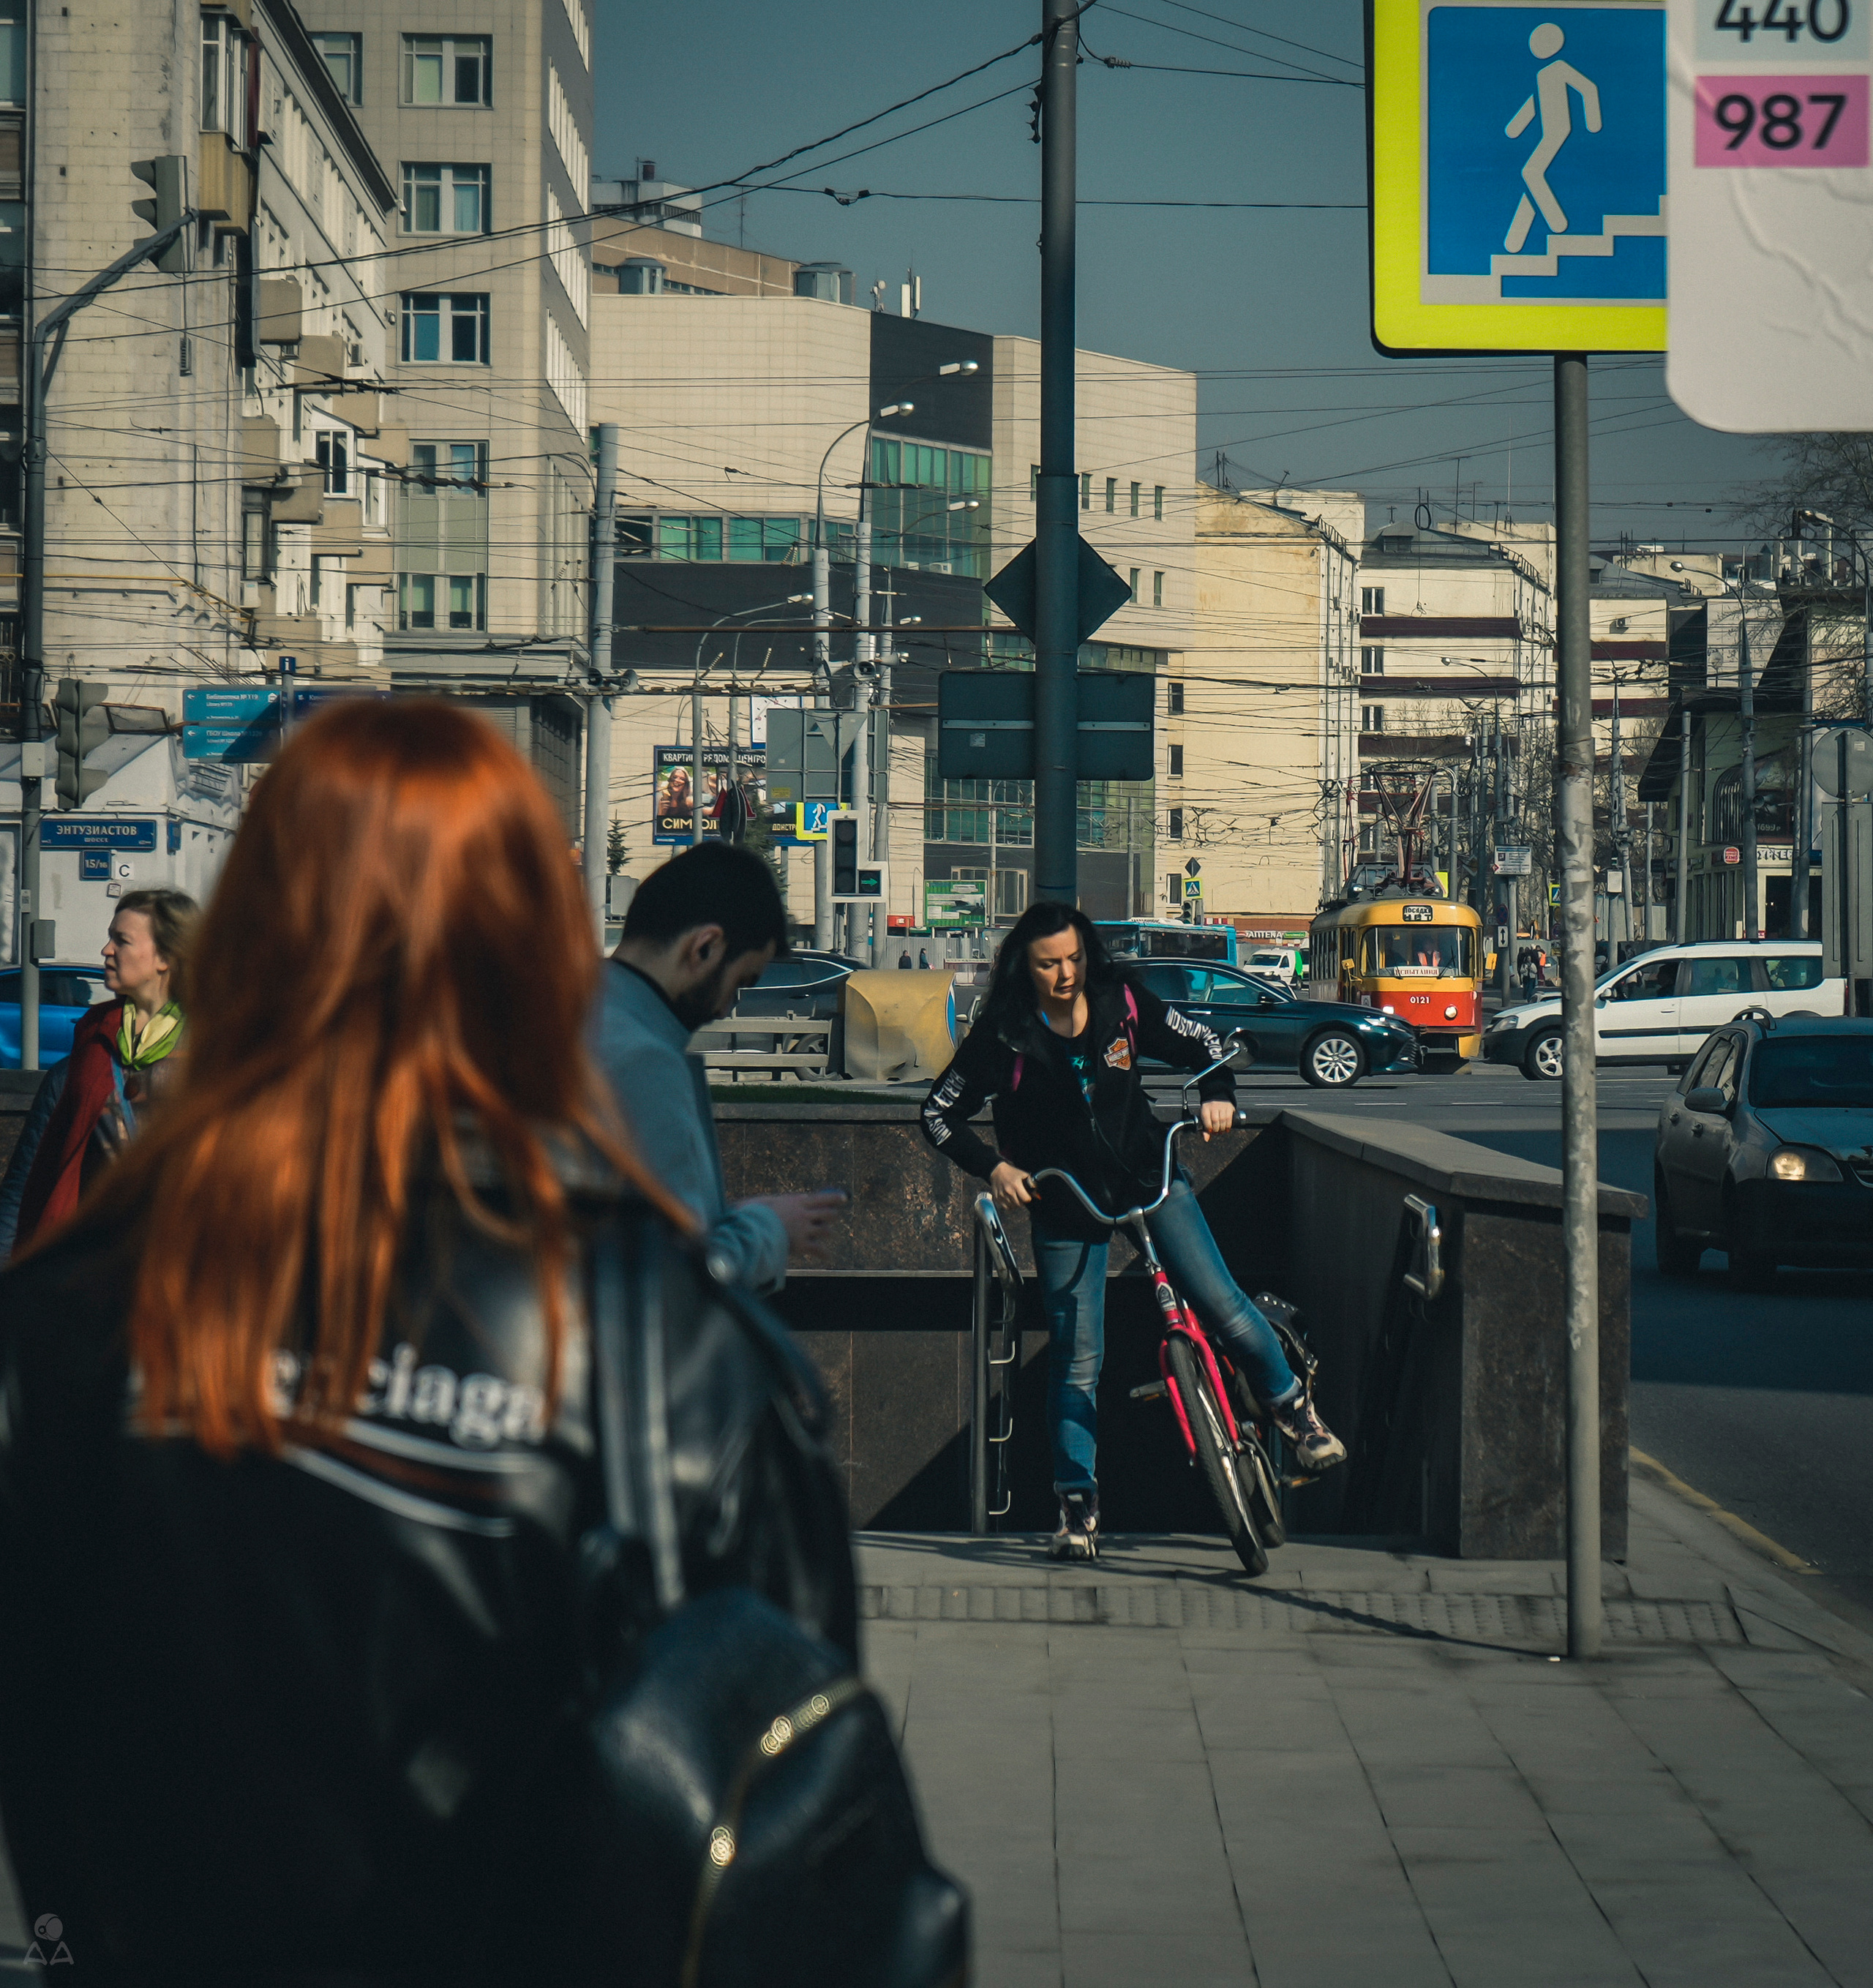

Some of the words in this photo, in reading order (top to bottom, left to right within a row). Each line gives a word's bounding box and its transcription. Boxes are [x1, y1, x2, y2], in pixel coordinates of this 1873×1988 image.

[1715, 0, 1850, 42] 440
[1714, 94, 1848, 151] 987
[663, 753, 694, 762] КВАРТИ
[738, 754, 766, 763] ЦЕНТРО
[662, 817, 717, 830] СИМОЛ
[772, 823, 797, 831] ДОНСТР
[56, 825, 137, 836] ЭНТУЗИАСТОВ
[1247, 931, 1283, 939] АПТЕКА
[1410, 996, 1430, 1004] 0121
